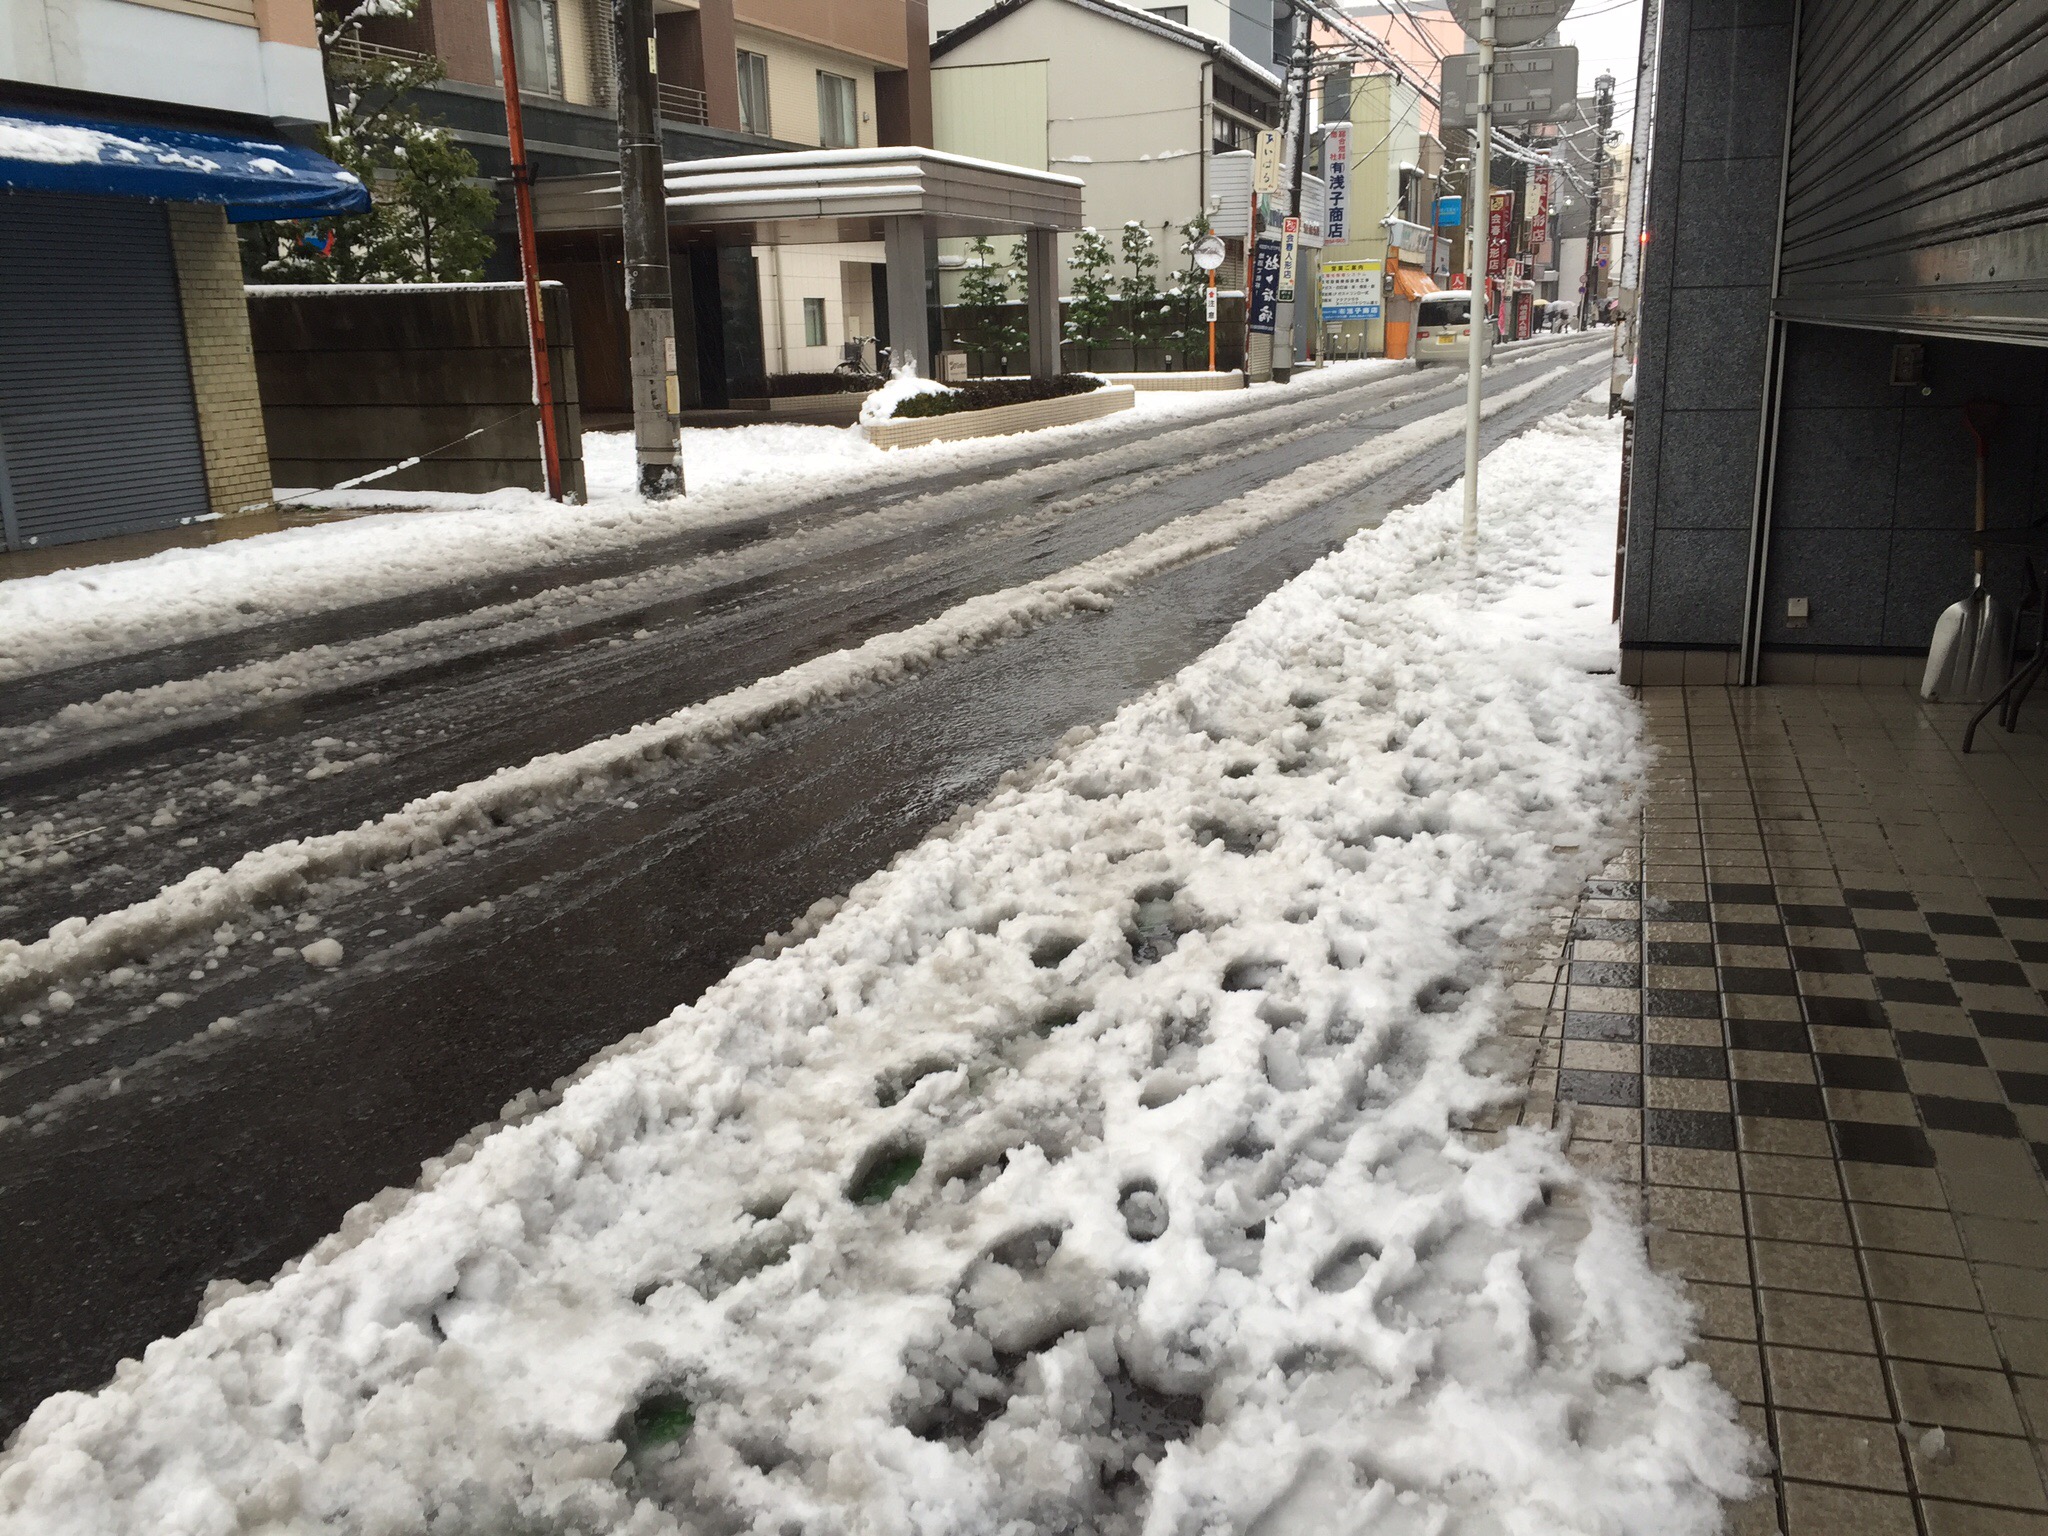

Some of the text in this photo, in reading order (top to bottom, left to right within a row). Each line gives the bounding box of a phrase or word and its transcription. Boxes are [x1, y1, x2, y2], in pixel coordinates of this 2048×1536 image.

[1283, 233, 1294, 279] 会春人形店
[1208, 300, 1215, 319] 注意
